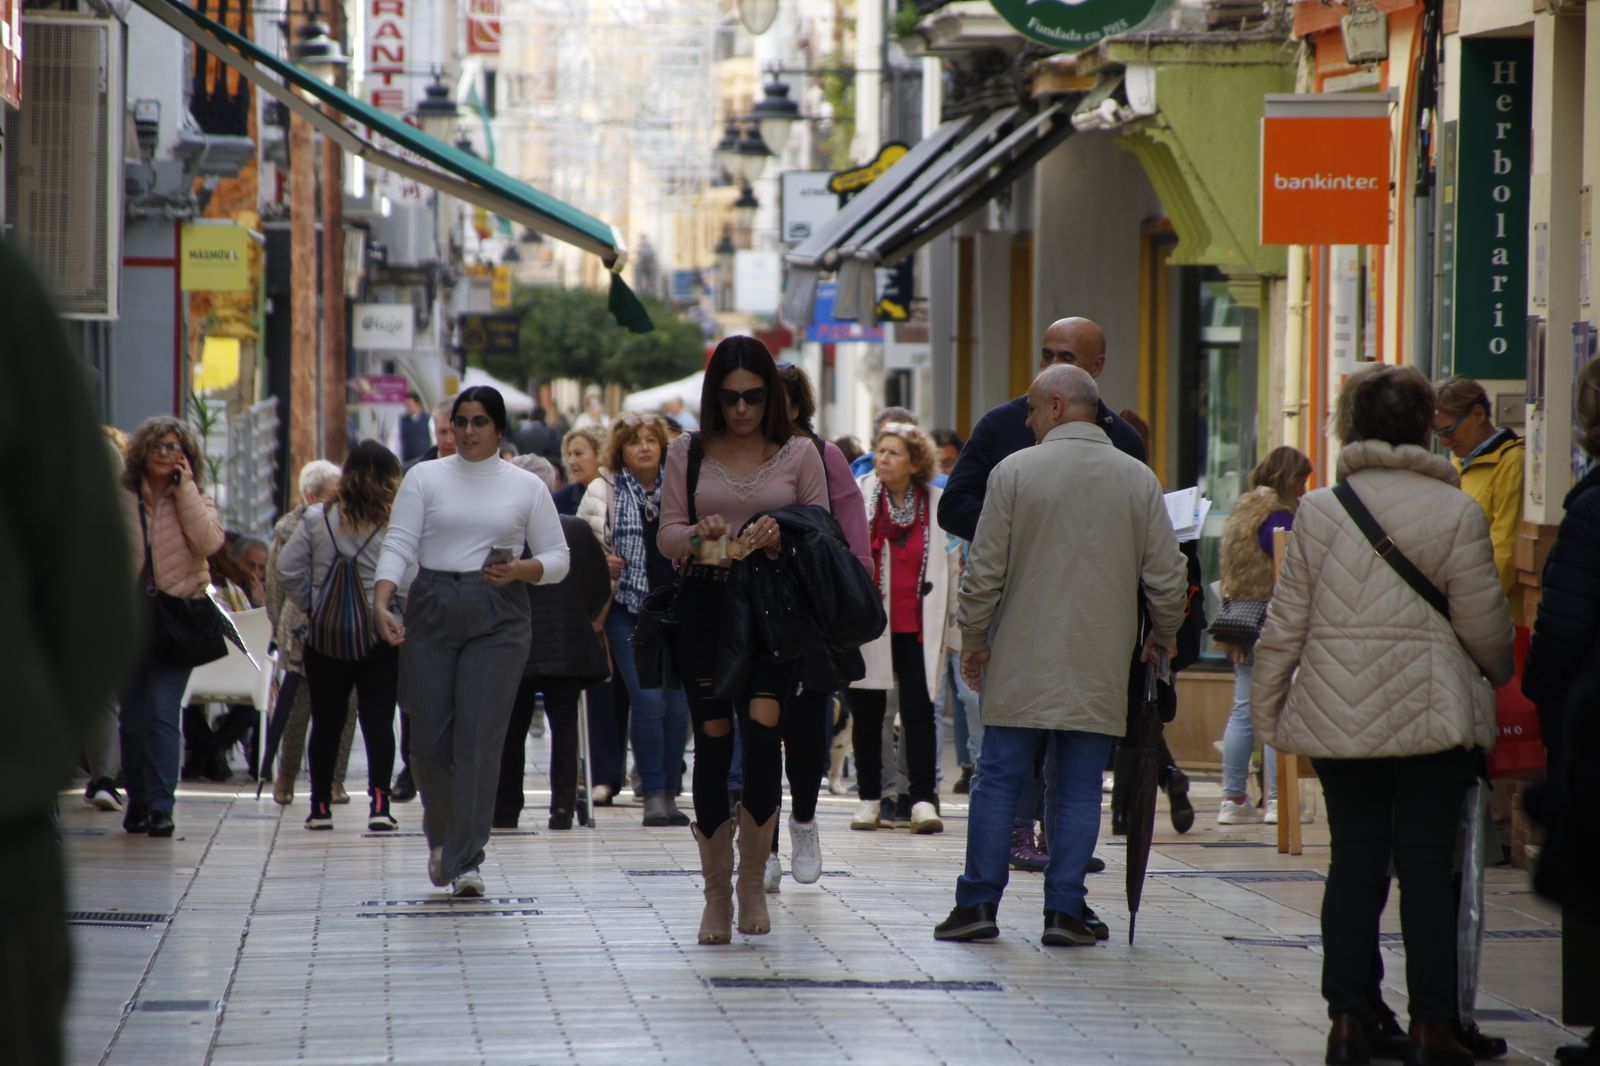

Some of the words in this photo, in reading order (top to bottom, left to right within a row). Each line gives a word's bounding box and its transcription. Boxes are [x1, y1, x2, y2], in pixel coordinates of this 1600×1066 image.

[1027, 17, 1081, 41] Fundada
[1084, 30, 1101, 40] en
[1488, 60, 1518, 355] Herbolario
